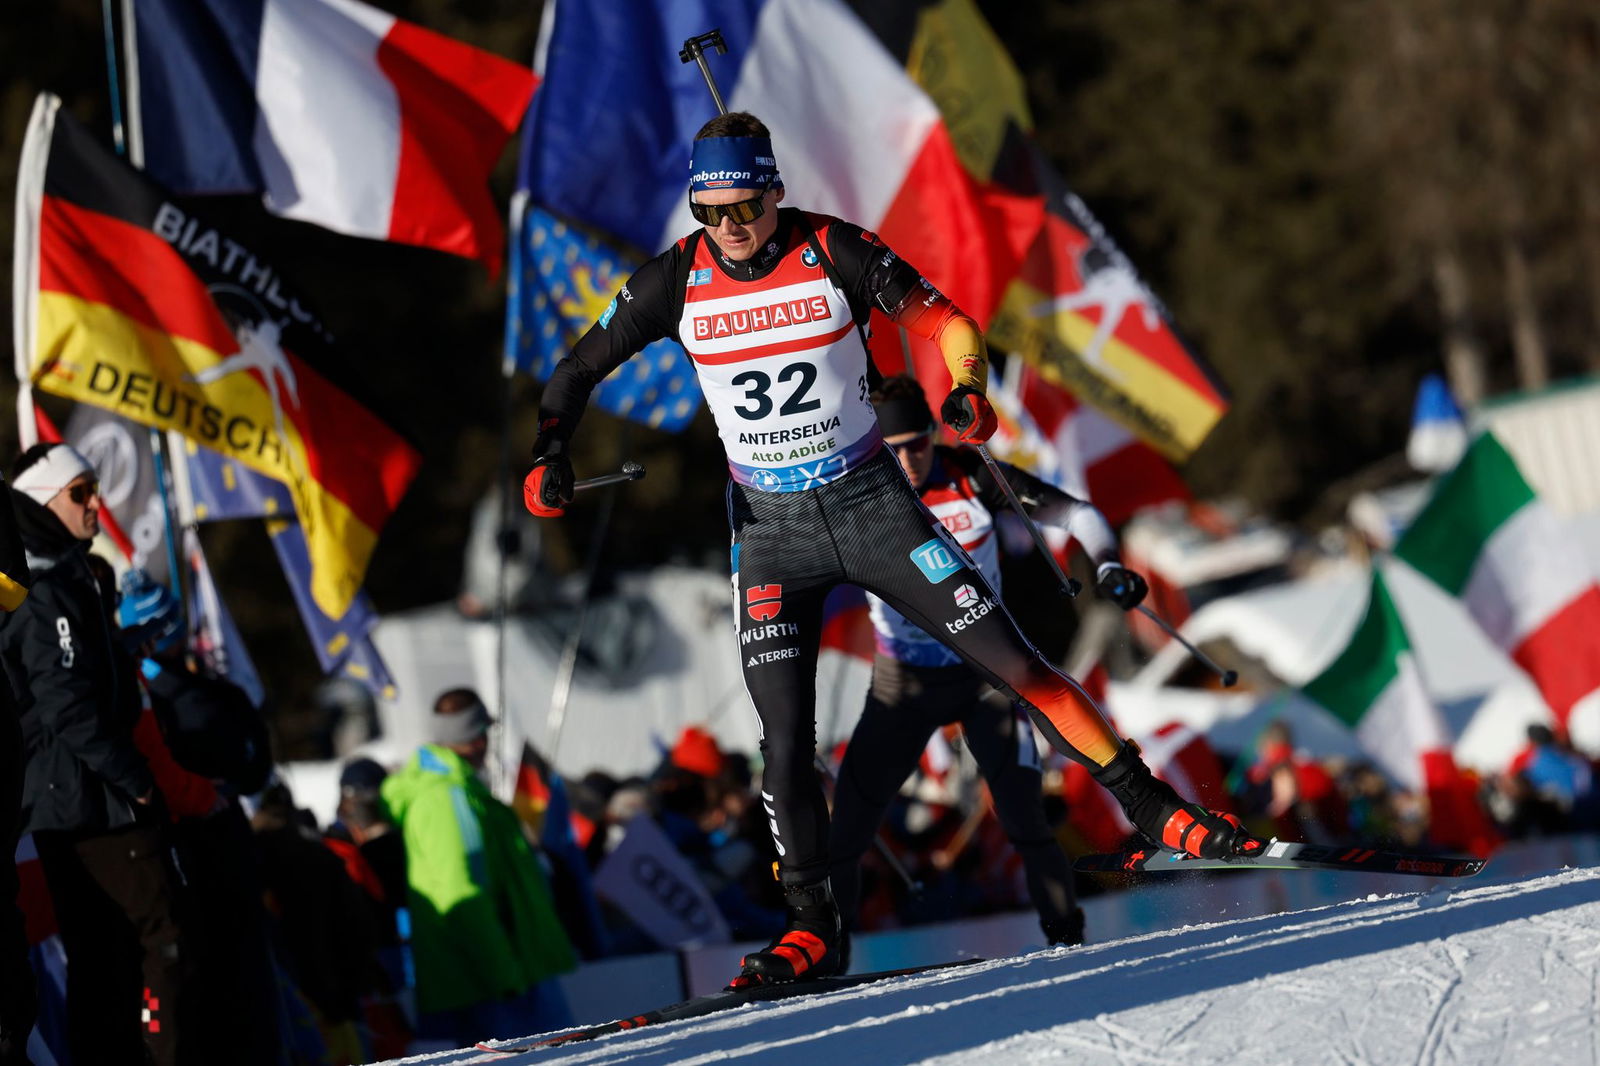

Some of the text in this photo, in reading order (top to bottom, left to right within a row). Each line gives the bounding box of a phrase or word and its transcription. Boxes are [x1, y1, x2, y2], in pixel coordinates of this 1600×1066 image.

[693, 170, 751, 182] robotron
[152, 202, 333, 342] BIATHL
[696, 298, 828, 337] BAUHAUS
[731, 362, 822, 421] 32
[739, 416, 841, 445] ANTERSELVA
[741, 622, 799, 646] WÜRTH
[758, 647, 801, 664] TERREX
